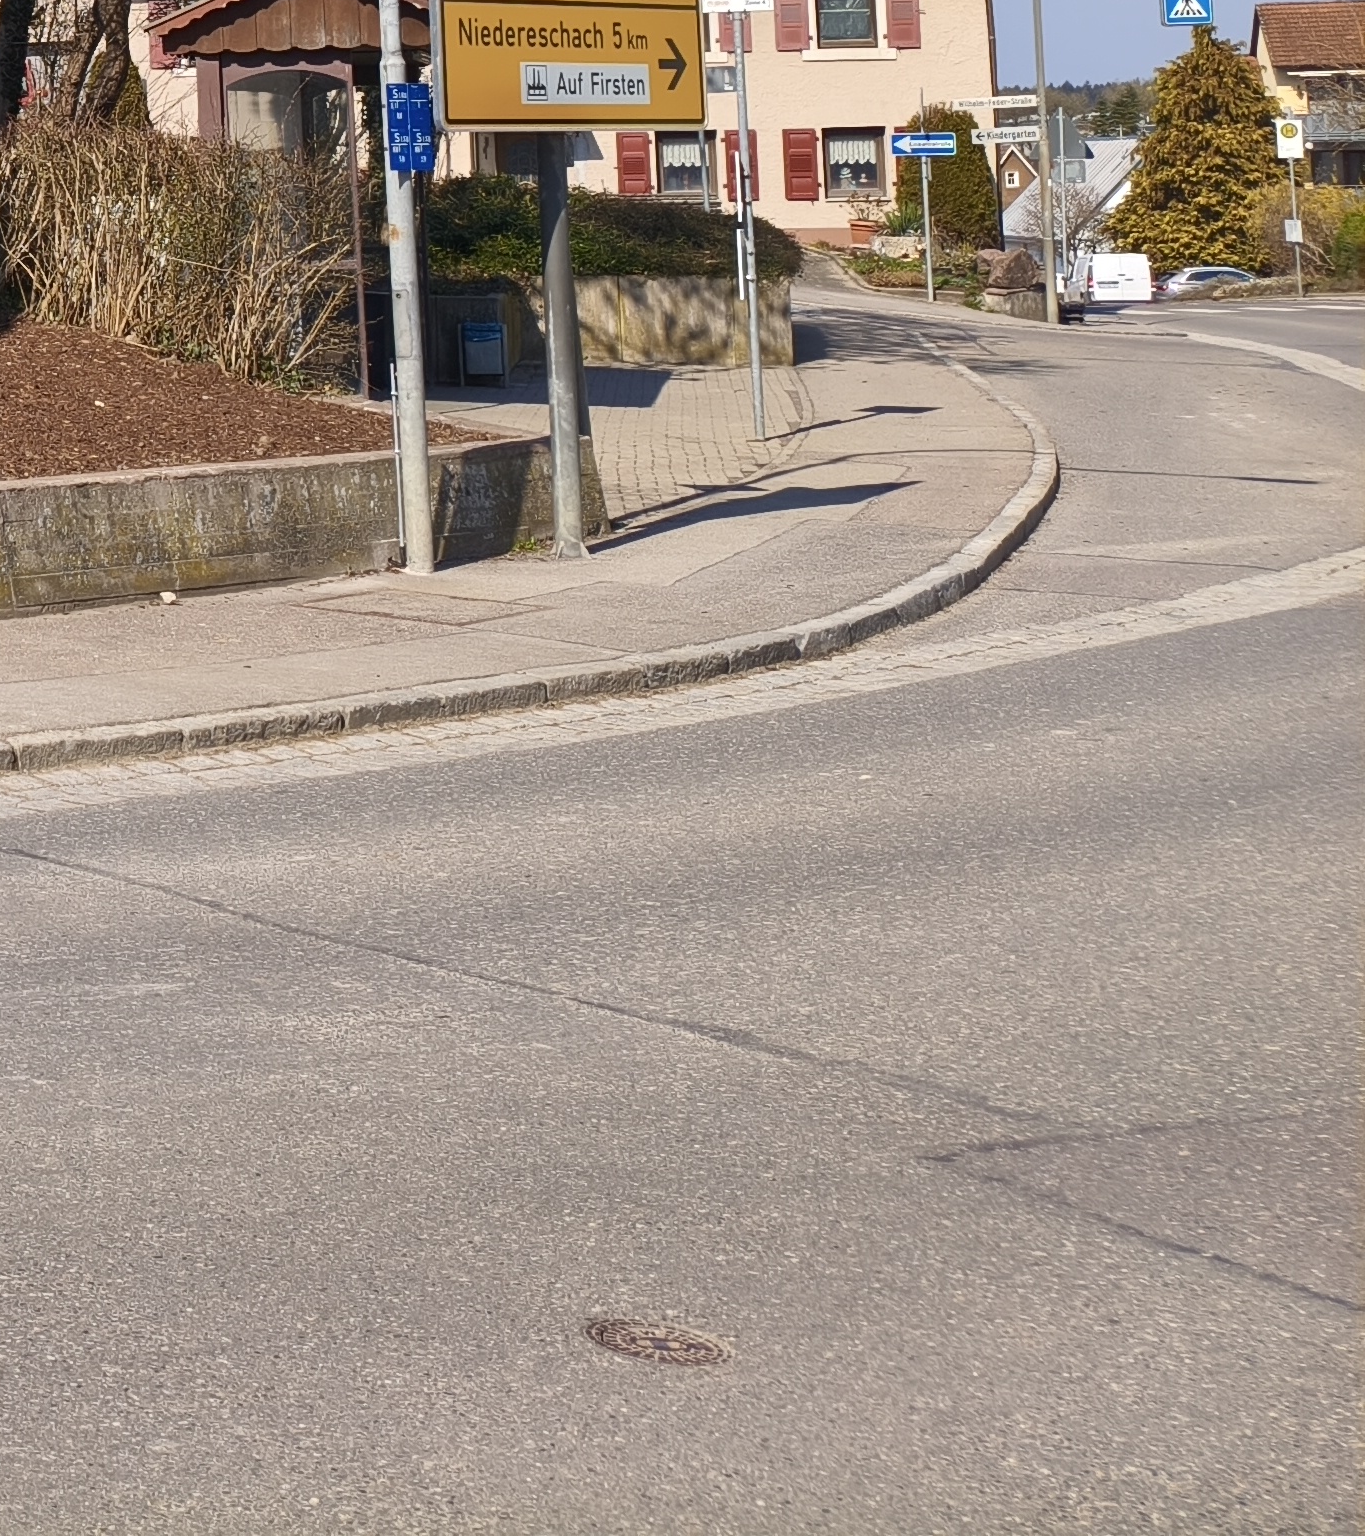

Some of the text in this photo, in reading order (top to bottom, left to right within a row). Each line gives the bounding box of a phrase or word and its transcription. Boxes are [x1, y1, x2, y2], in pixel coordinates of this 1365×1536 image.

[458, 17, 648, 50] Niedereschach 5 km
[556, 71, 646, 96] Auf Firsten
[986, 130, 1037, 141] Kindergarten
